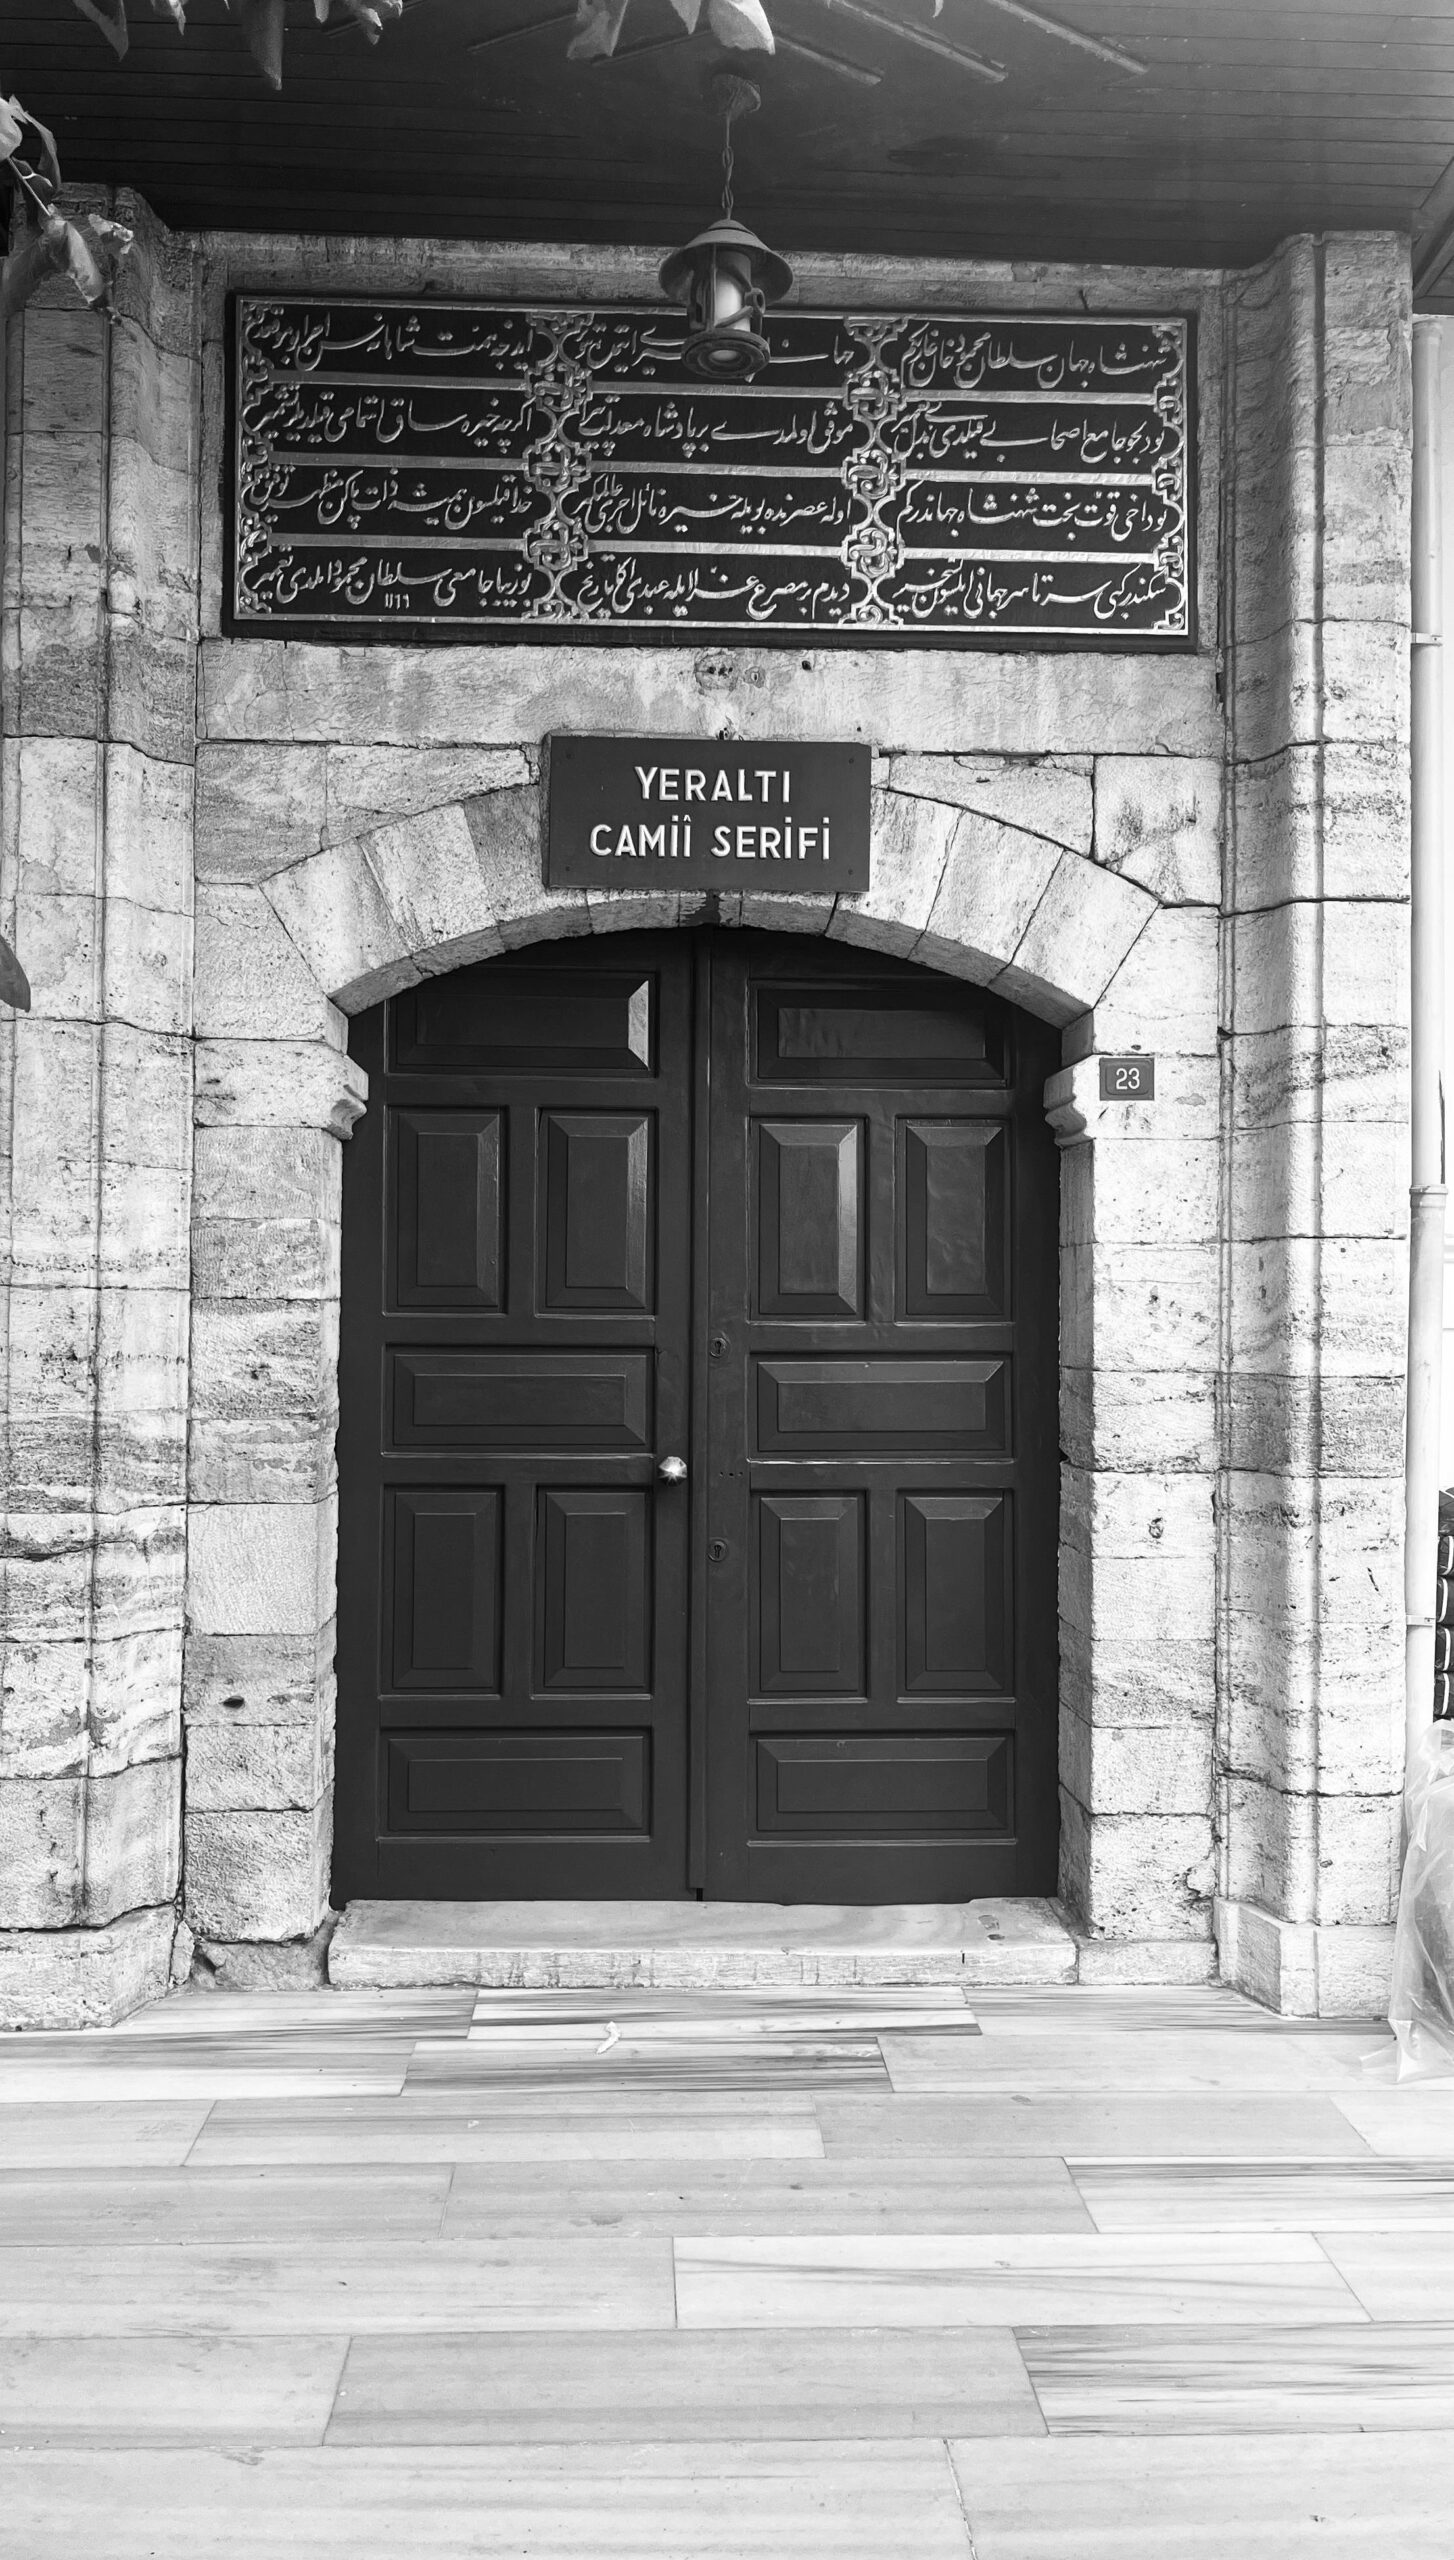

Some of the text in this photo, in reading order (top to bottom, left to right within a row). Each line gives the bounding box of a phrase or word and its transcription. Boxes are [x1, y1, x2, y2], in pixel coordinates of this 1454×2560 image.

[634, 766, 790, 803] YERALTI
[710, 816, 831, 861] SERİFİ
[1115, 1067, 1141, 1090] 23
